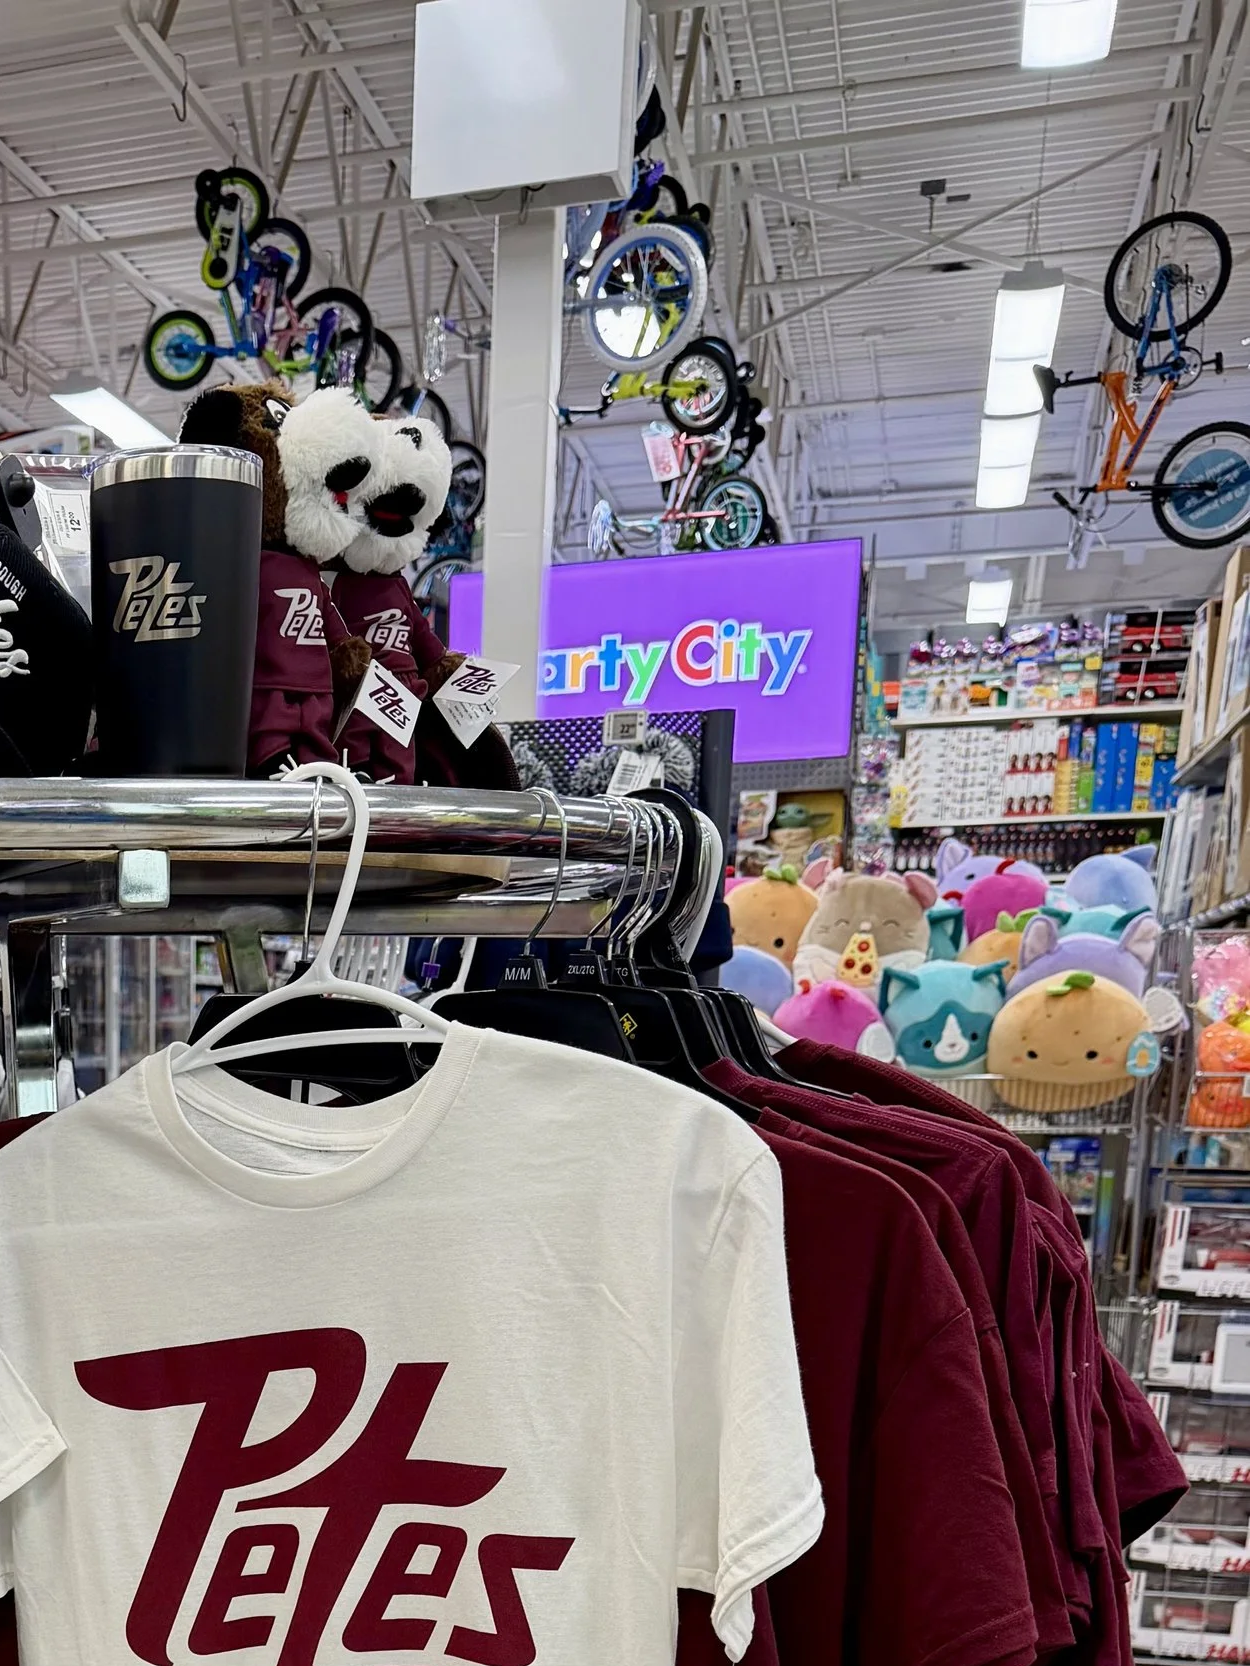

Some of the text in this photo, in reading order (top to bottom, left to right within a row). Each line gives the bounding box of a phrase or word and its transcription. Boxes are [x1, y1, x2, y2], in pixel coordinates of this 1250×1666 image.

[109, 555, 207, 642] Petes
[273, 588, 327, 645] Pete
[363, 608, 410, 655] Pete
[449, 664, 499, 696] Petes
[539, 620, 811, 704] arty City
[367, 672, 412, 730] Petes
[504, 967, 531, 981] M/M
[567, 964, 595, 976] 2XL/2TG
